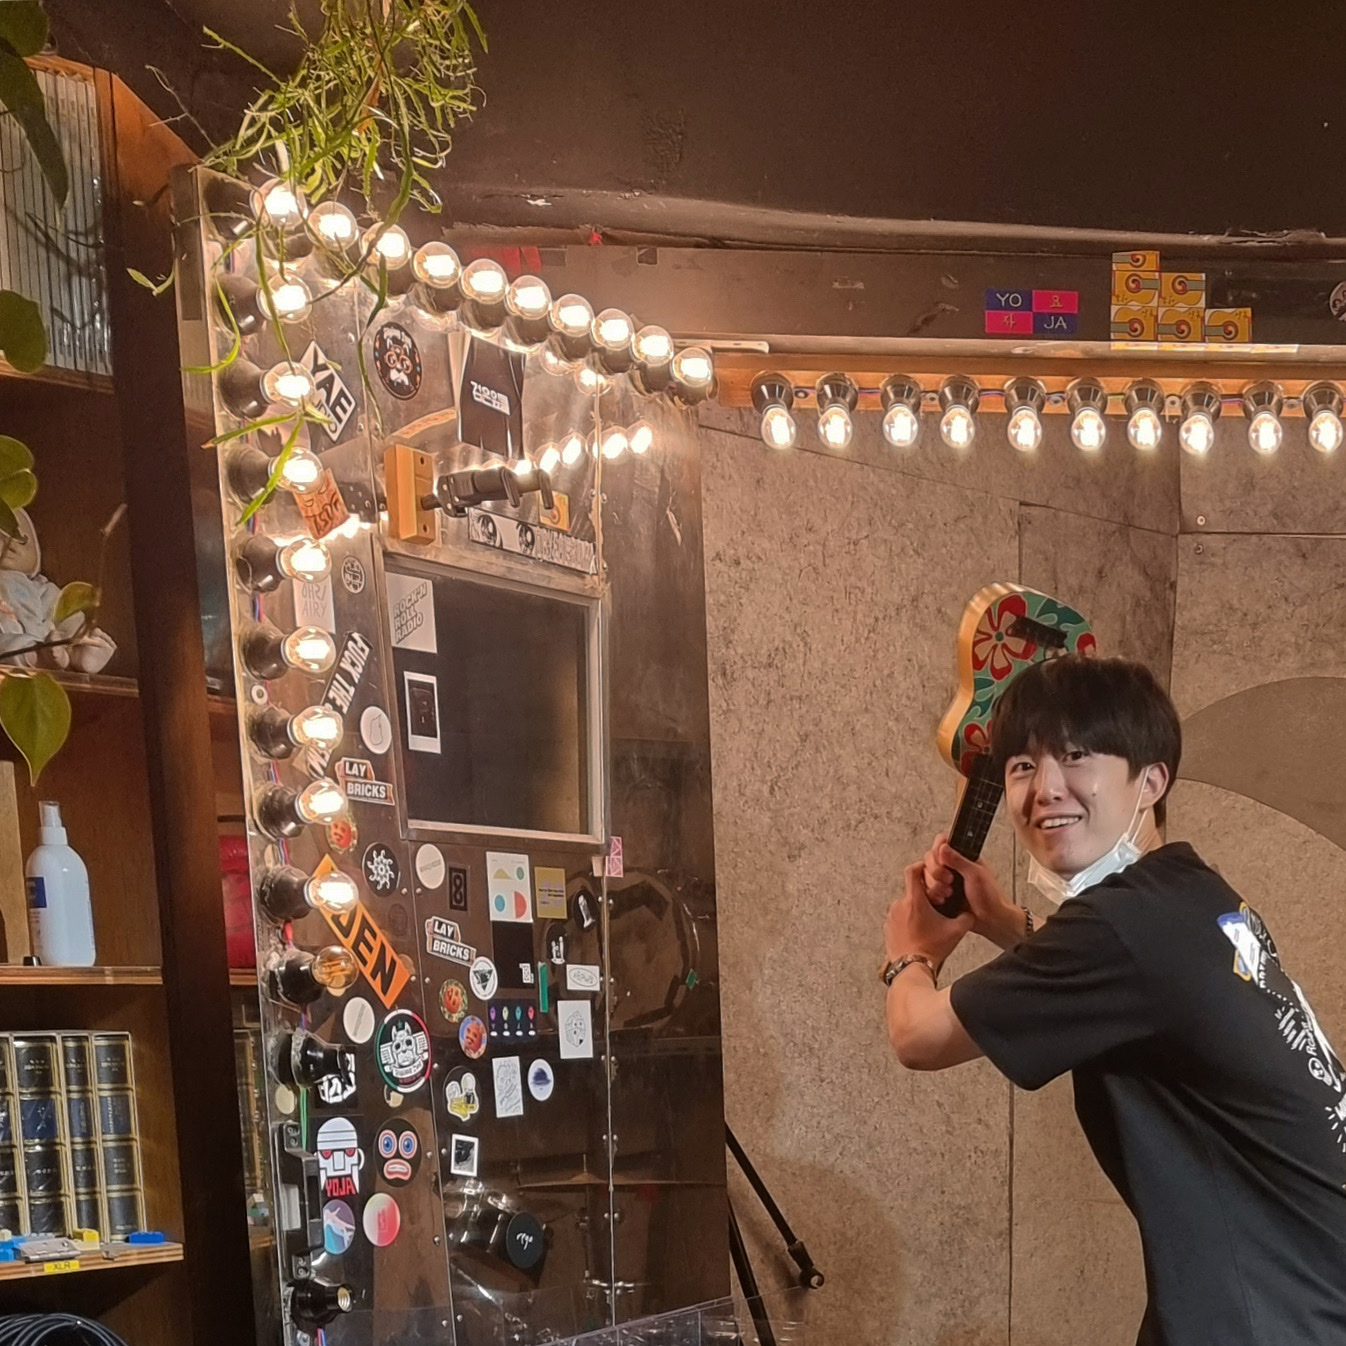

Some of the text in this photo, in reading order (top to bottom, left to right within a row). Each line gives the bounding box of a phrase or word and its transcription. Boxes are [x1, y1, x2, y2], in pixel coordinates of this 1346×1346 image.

[996, 293, 1063, 308] YO 요
[1044, 316, 1067, 330] JA
[301, 601, 328, 618] AIRY
[393, 604, 417, 630] ROLL
[394, 615, 424, 644] RADIO
[328, 632, 370, 714] FUCK THE
[344, 761, 367, 777] LAY
[346, 782, 387, 798] BRICKS
[433, 920, 454, 937] LAY
[433, 939, 470, 961] BRICKS
[325, 1177, 357, 1197] YOJA
[516, 1232, 535, 1250] rego
[52, 1261, 72, 1272] XLR
